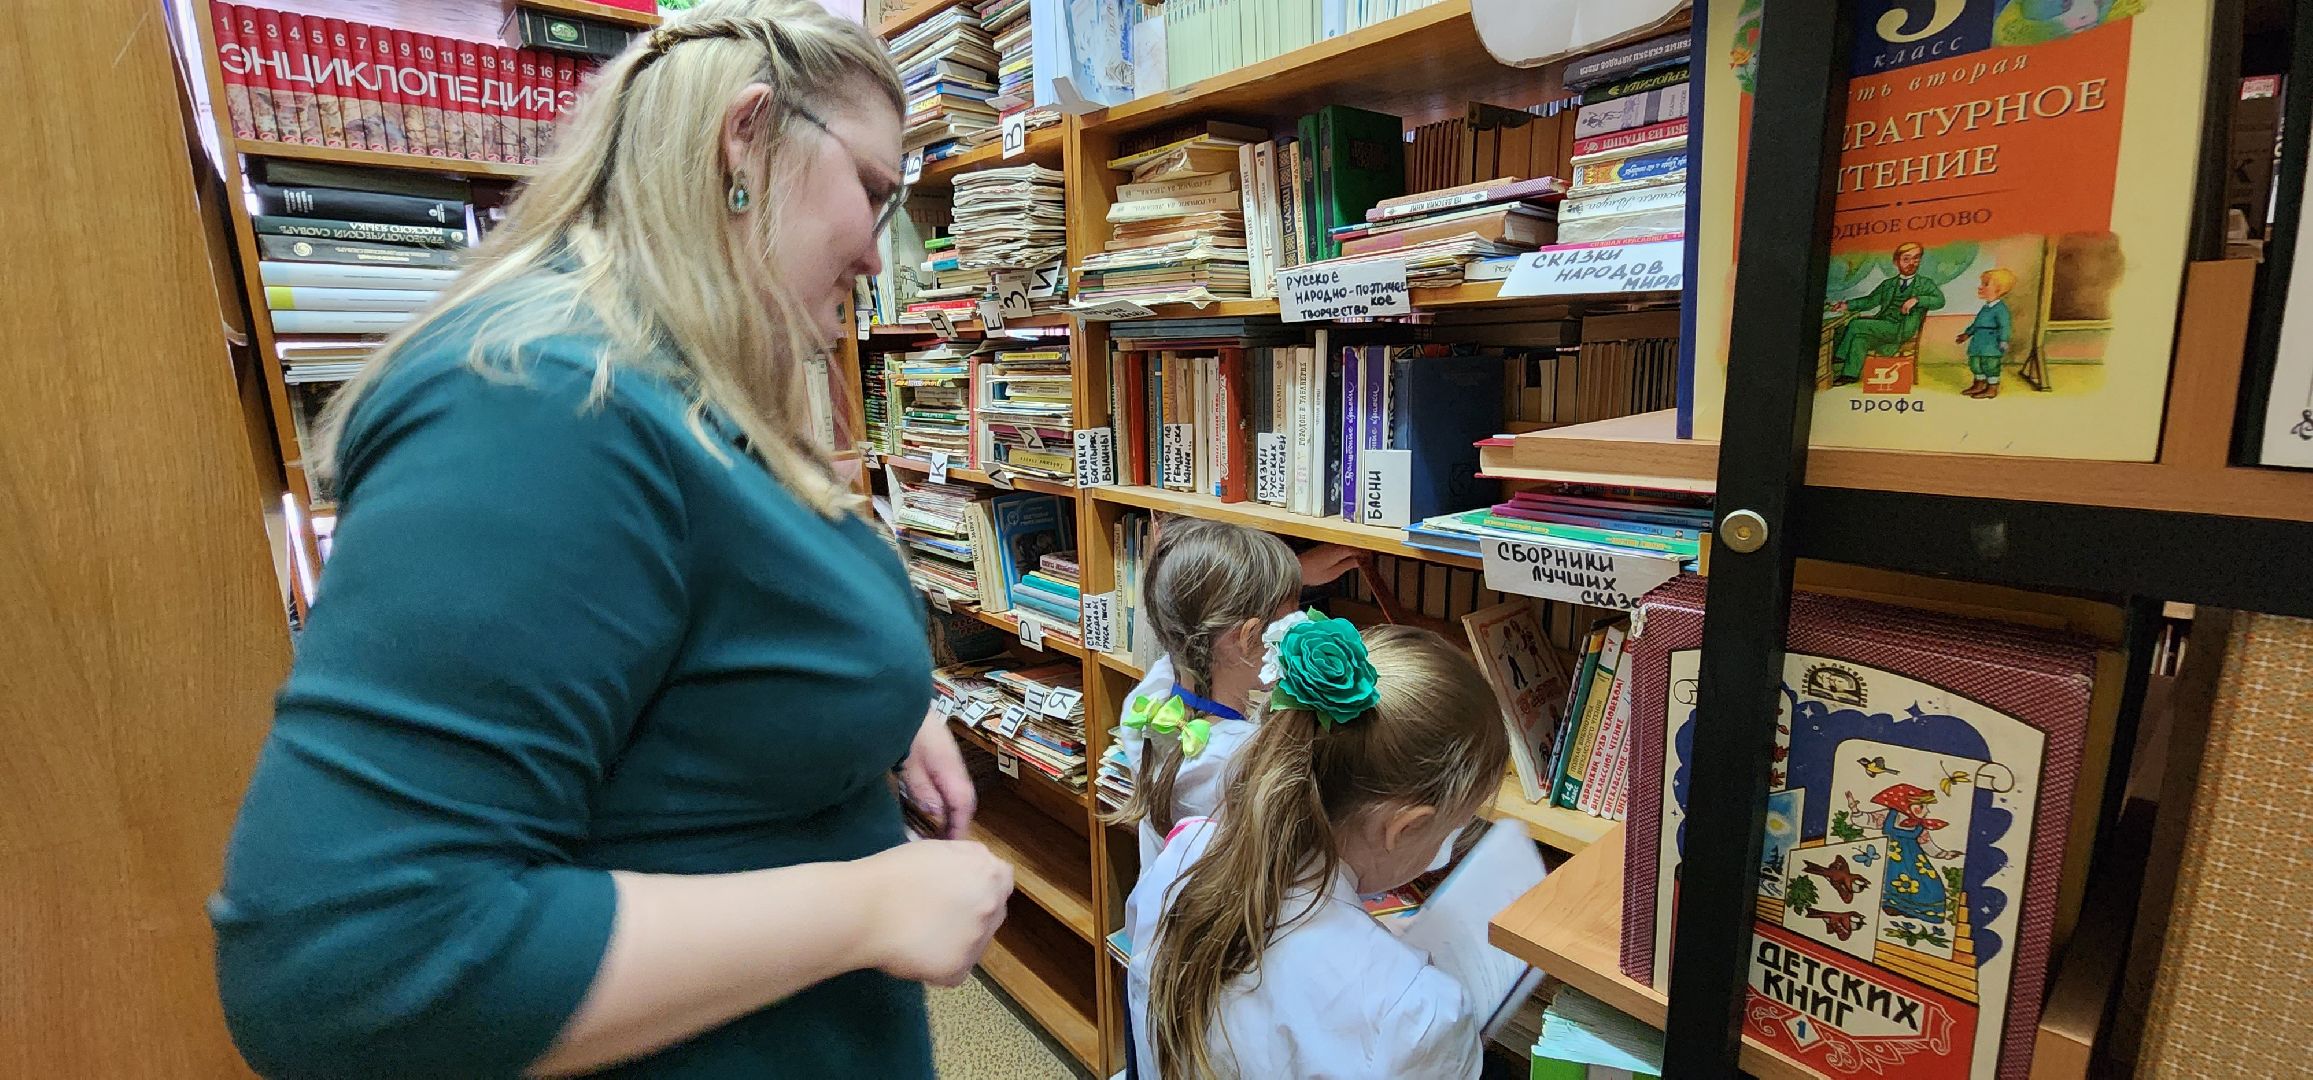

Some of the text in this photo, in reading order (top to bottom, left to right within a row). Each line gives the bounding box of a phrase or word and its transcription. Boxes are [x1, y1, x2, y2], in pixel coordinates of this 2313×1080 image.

[221, 17, 228, 31] 1
[244, 20, 255, 34] 2
[266, 24, 278, 38] 3
[290, 26, 300, 40] 4
[312, 30, 324, 44] 5
[334, 33, 346, 47] 6
[356, 37, 366, 50] 7
[379, 40, 390, 54] 8
[400, 42, 410, 55] 9
[418, 45, 434, 60] 10
[1873, 36, 1963, 68] класс
[441, 51, 454, 64] 11
[460, 54, 475, 66] 12
[482, 56, 496, 68] 13
[501, 59, 515, 72] 14
[220, 43, 554, 113] ЭНЦИКЛОПЕДИЯ
[522, 63, 535, 76] 15
[539, 66, 553, 79] 16
[559, 69, 572, 81] 17
[1908, 53, 2029, 92] вторая
[1004, 123, 1022, 153] В
[1281, 187, 1293, 233] СКАЗКИ
[1907, 208, 1992, 232] СЛОВО
[279, 225, 331, 238] СЛОВАРЬ
[1532, 249, 1623, 269] СКАЗКИ
[1286, 271, 1340, 290] РУССКОЕ
[1554, 260, 1664, 282] НАРОДОВ
[1622, 274, 1682, 290] МИРА
[1301, 305, 1369, 319] ТВОРЧЕСТВО
[1078, 444, 1089, 486] СКАЗКИ
[1102, 434, 1112, 482] БЫЛИНЫ
[1277, 434, 1287, 498] ПИСАТЕЛЕЙ
[931, 461, 945, 477] К
[1259, 447, 1269, 499] СКАЗКИ
[1269, 443, 1277, 499] РУССКИХ
[1368, 470, 1383, 520] БАСНИ
[1497, 541, 1614, 573] СБОРНИКИ
[1532, 566, 1617, 592] ЛУЧШИХ
[1020, 619, 1040, 646] Р
[1049, 692, 1077, 711] Я
[1608, 717, 1625, 752] ЧТЕНИЕ
[1561, 781, 1574, 801] 1-4
[1757, 941, 1920, 1032] ДЕТСКИХ
[1763, 969, 1854, 1028] КНИГ
[1797, 1020, 1807, 1040] 1
